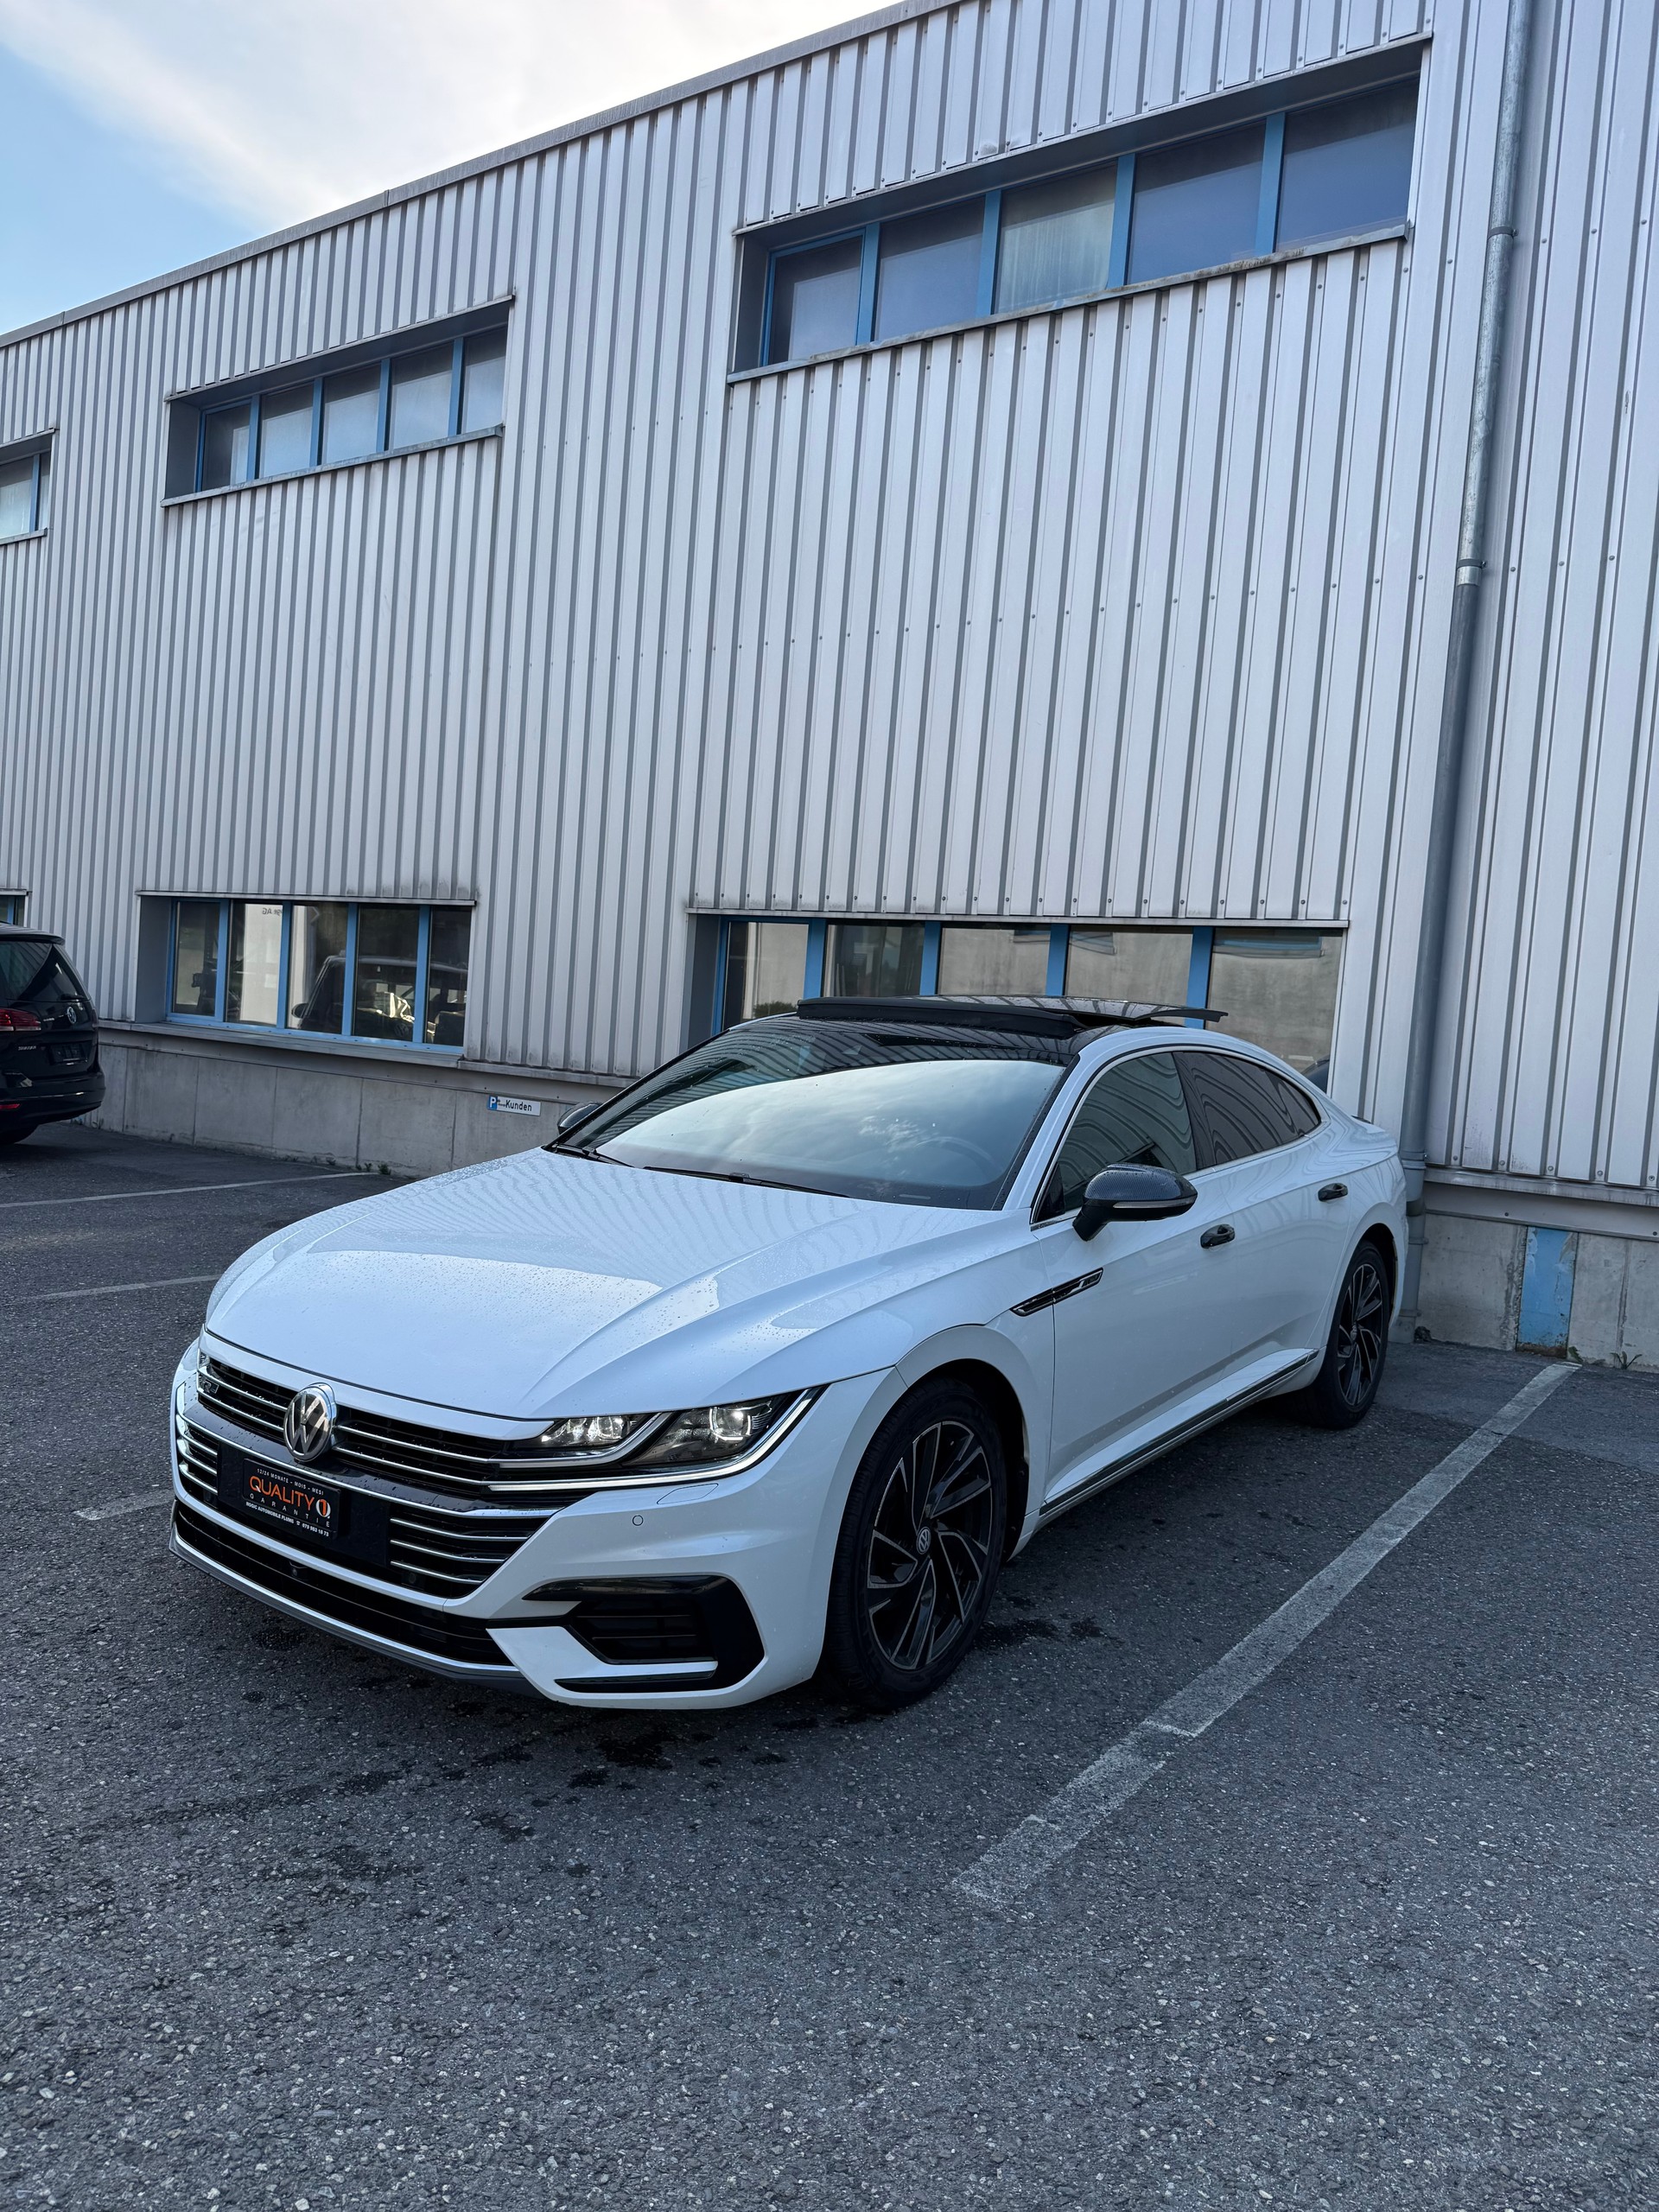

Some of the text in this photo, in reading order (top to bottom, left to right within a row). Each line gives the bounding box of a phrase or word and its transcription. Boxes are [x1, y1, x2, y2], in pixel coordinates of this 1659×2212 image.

[505, 1099, 532, 1112] Kunden
[270, 1472, 289, 1484] MONATE
[294, 1480, 307, 1490] MOIS
[250, 1493, 330, 1528] GARANTIE
